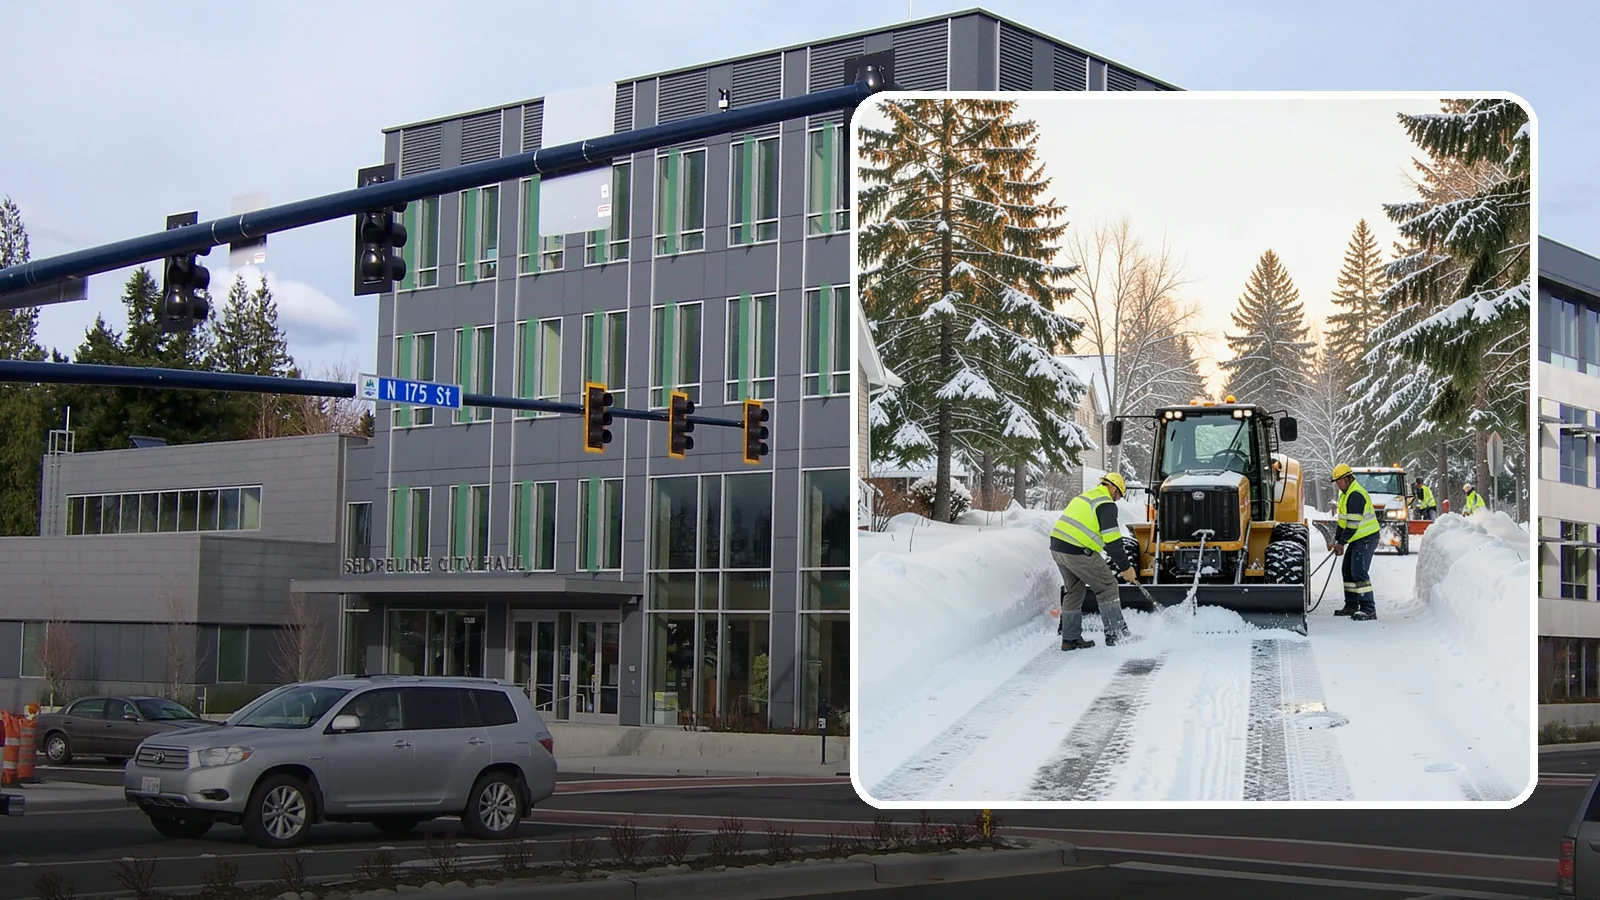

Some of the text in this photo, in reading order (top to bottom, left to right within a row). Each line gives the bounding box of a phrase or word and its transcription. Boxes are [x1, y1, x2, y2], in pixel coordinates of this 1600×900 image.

[387, 380, 451, 406] N 175 St
[344, 555, 526, 574] SHORELINE CITY HALL
